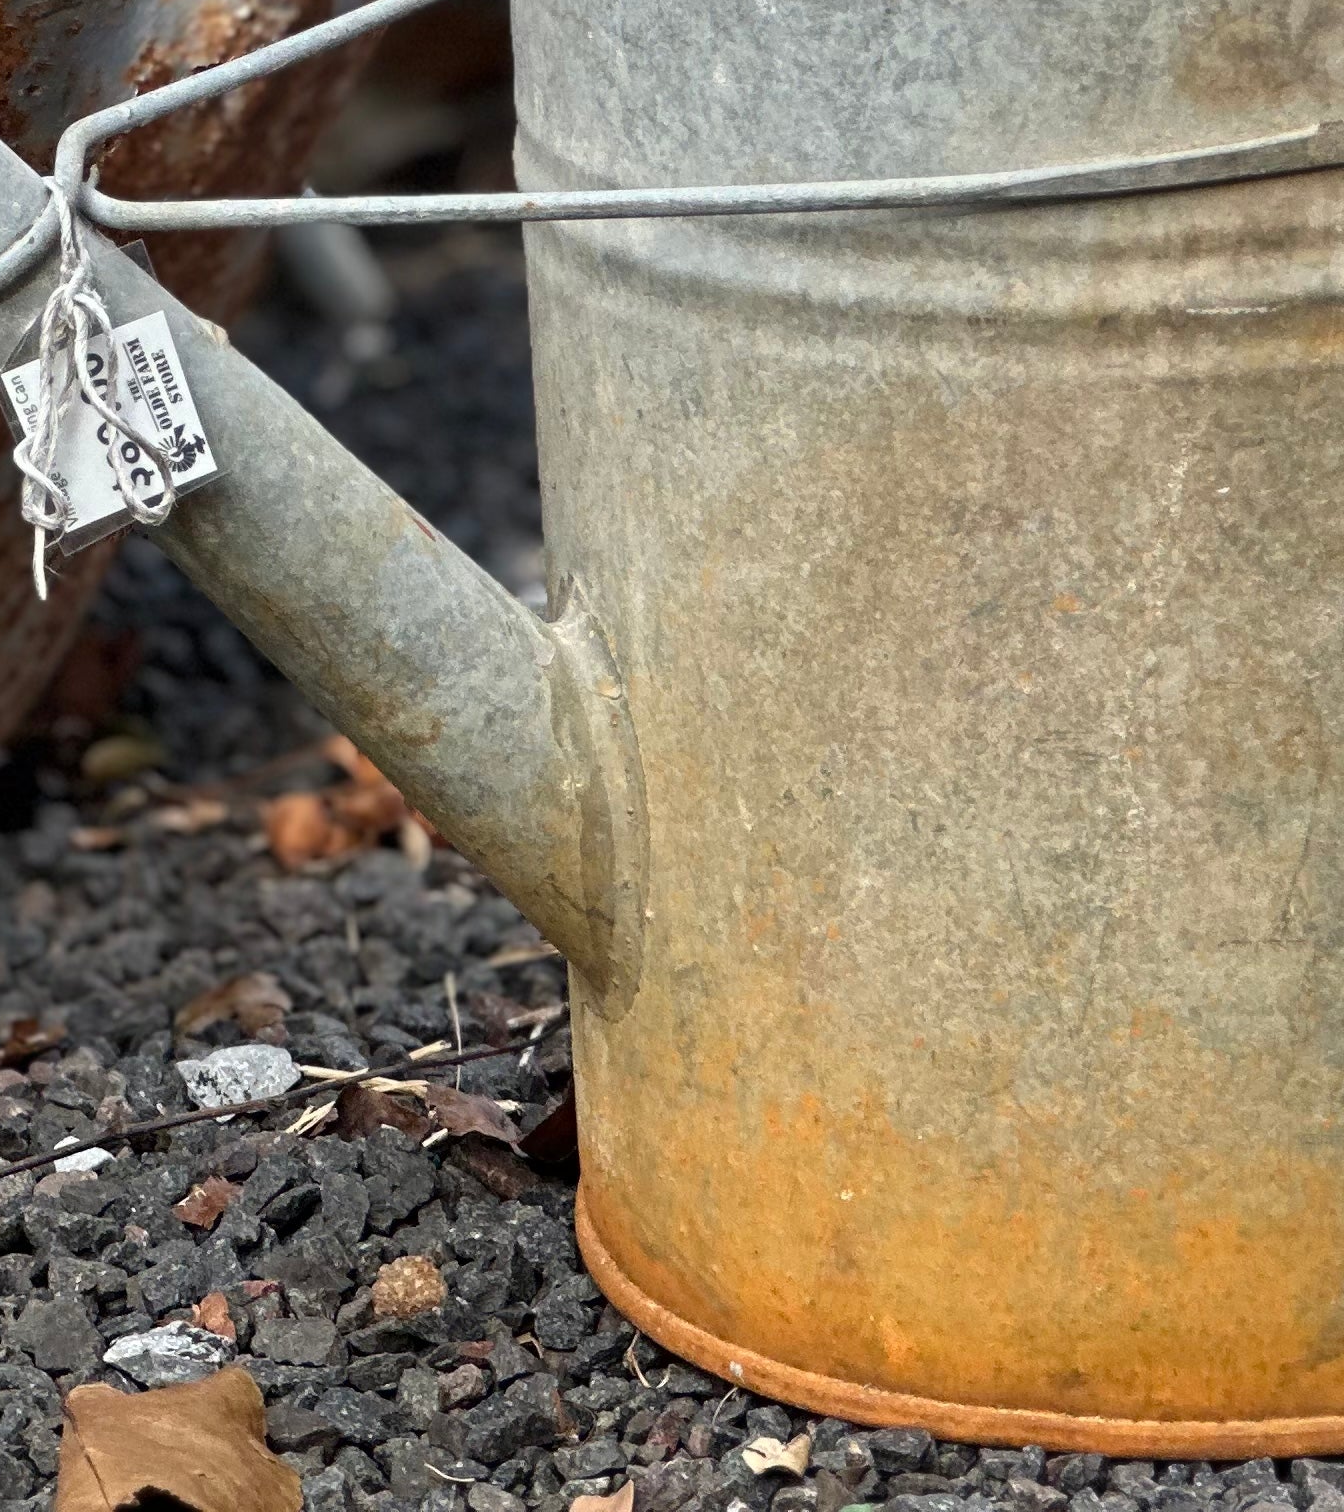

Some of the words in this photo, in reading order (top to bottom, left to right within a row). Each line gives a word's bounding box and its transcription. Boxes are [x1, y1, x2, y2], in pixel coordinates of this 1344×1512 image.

[126, 337, 156, 385] FARM
[151, 349, 183, 404] STORE
[10, 375, 29, 405] Can
[126, 377, 143, 403] THE
[145, 386, 173, 430] OLDE
